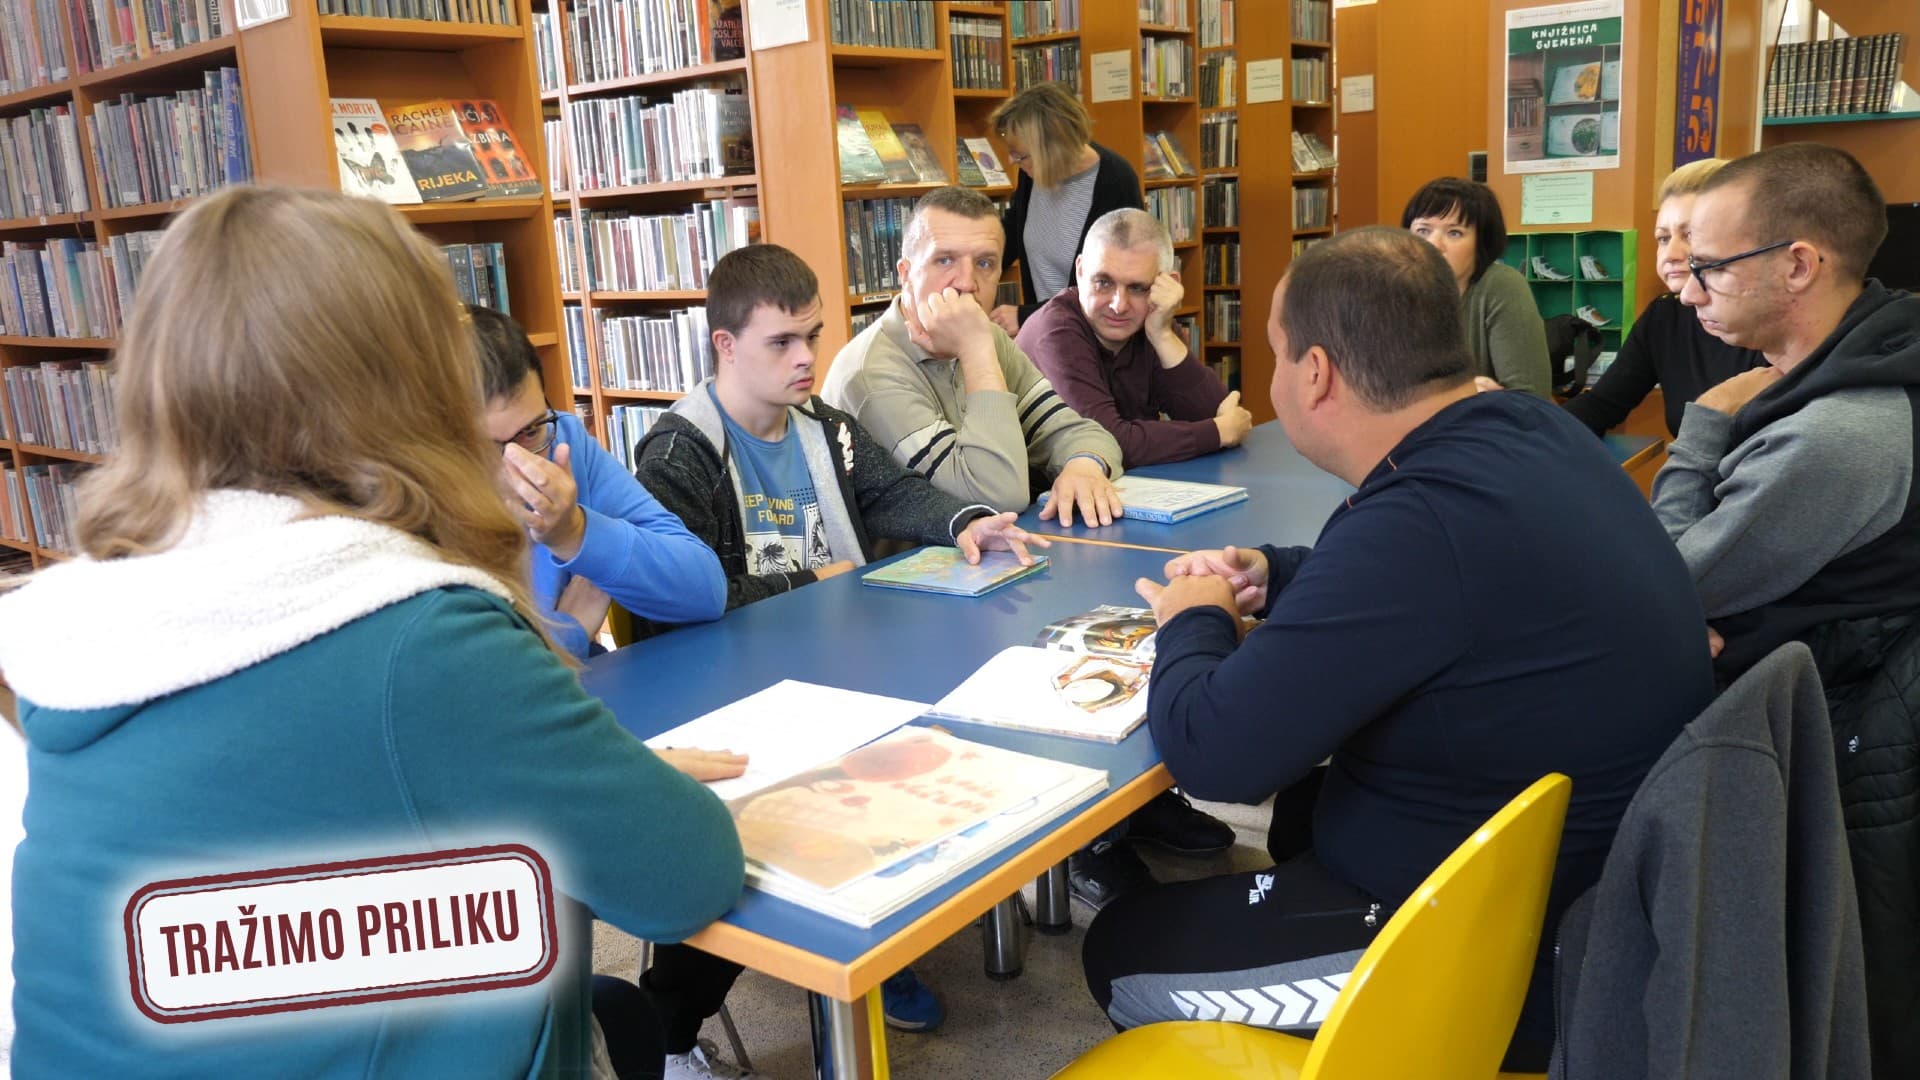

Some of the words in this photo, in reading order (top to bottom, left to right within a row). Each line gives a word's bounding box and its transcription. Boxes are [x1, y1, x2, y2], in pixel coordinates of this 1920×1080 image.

[1531, 23, 1598, 40] KNJIŽNICA
[391, 107, 446, 125] RACHEL
[395, 117, 456, 135] CAINE
[418, 170, 478, 190] RIJEKA
